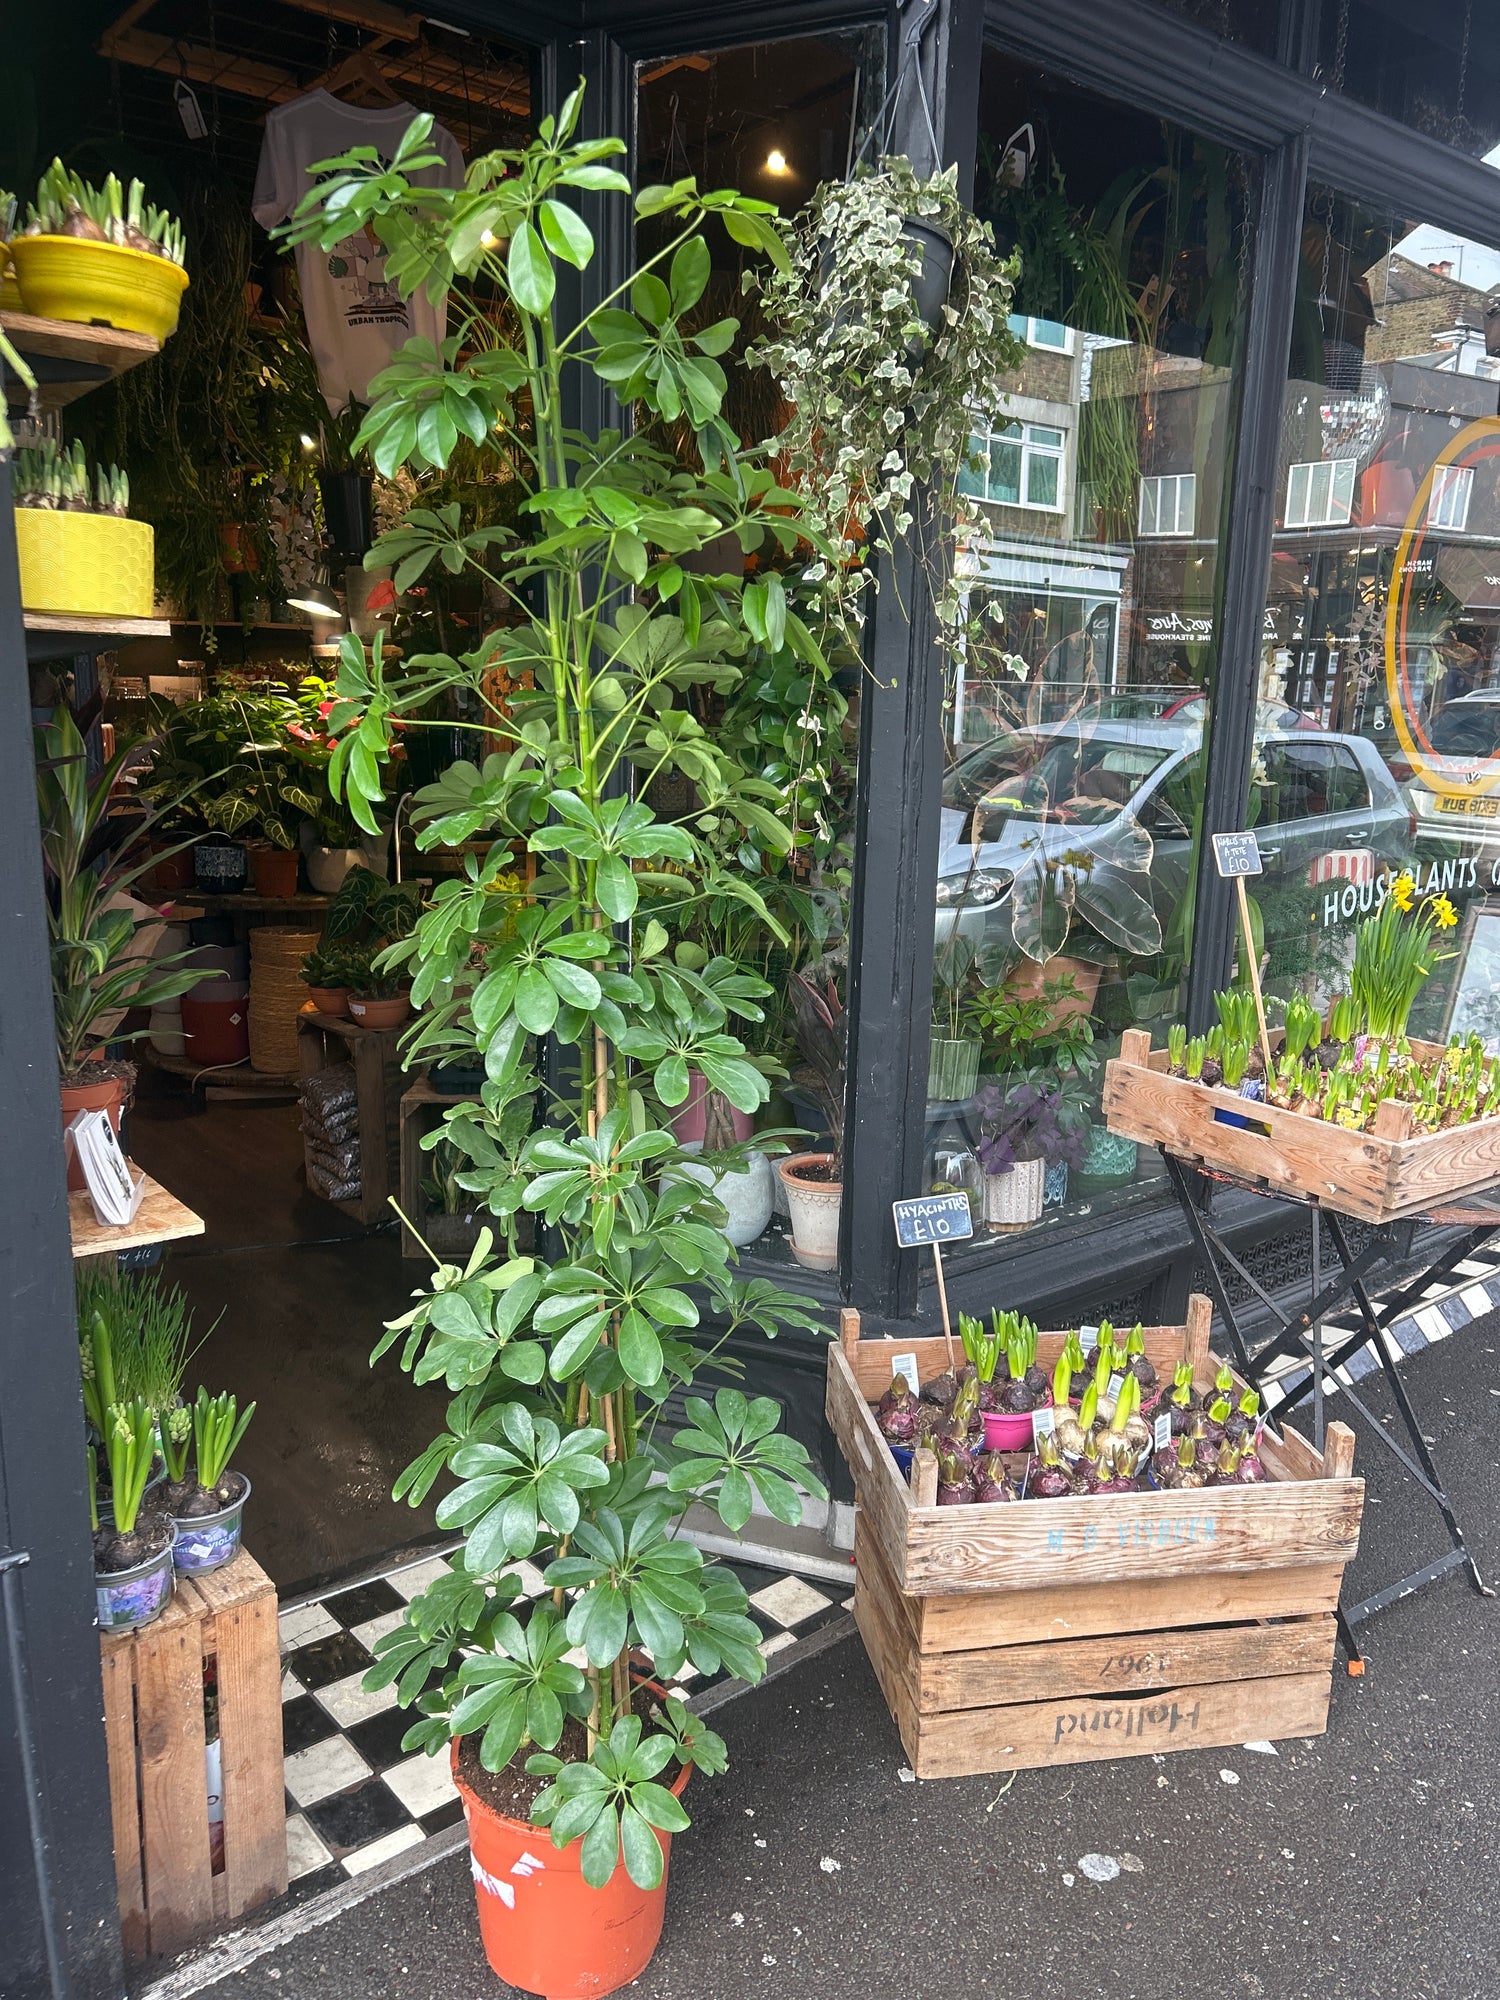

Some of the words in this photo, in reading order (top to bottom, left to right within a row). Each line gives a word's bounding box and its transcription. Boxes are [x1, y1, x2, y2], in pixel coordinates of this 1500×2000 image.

[348, 316, 374, 327] URBAN
[1224, 847, 1230, 857] A
[1231, 846, 1247, 857] TETE
[1229, 857, 1250, 873] £10
[898, 1196, 968, 1219] HYACINTHS
[913, 1218, 950, 1240] £10
[1054, 1702, 1201, 1744] Holland
